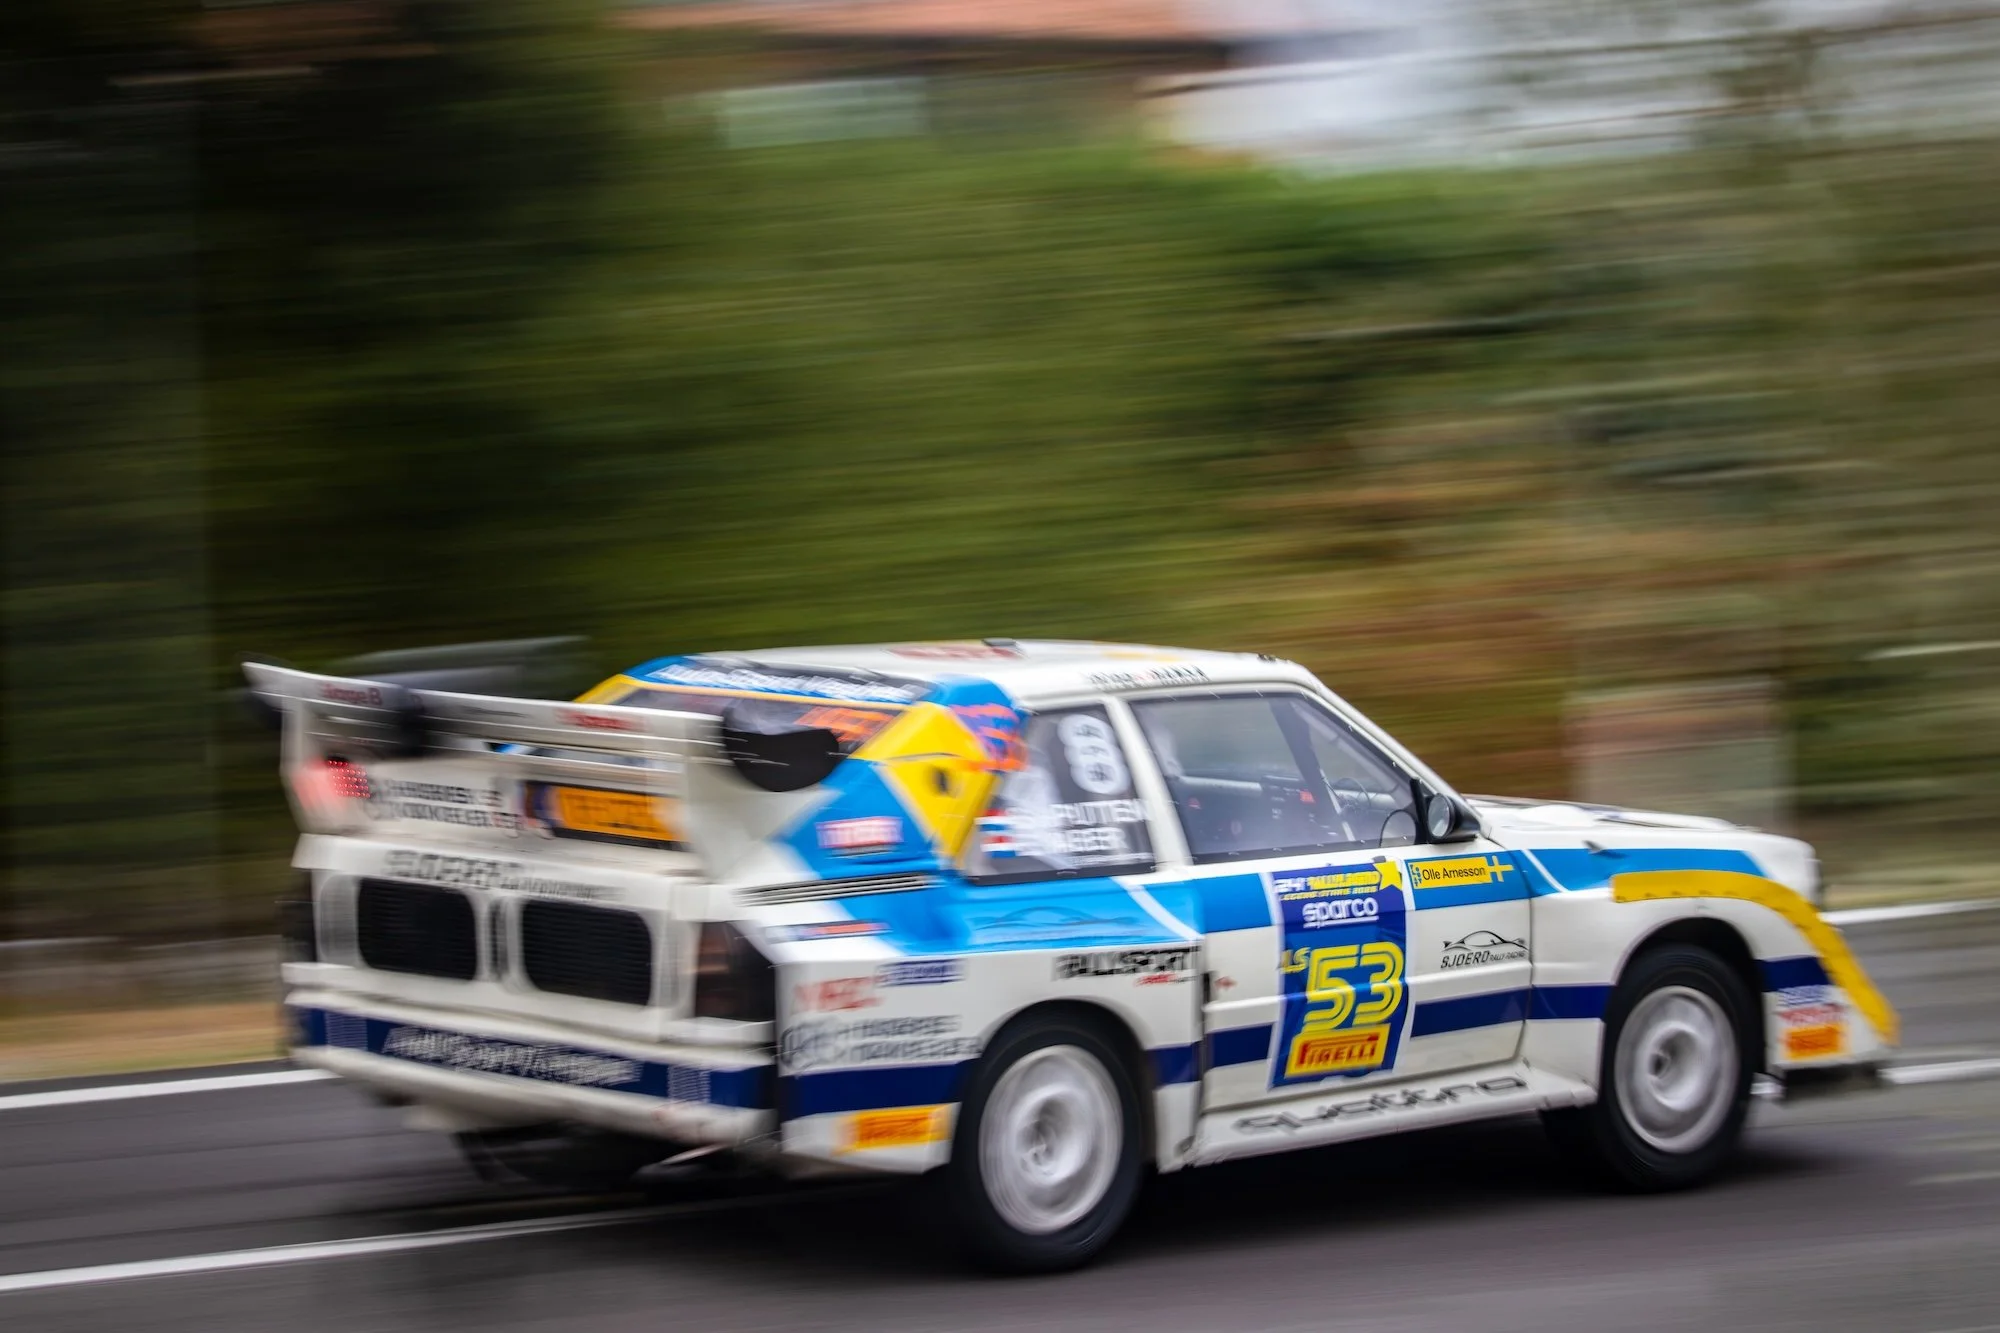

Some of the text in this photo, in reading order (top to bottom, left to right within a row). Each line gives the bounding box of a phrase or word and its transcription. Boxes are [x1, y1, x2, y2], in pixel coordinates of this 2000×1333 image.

[1422, 867, 1486, 881] Olle Arnesson
[1302, 897, 1379, 928] sparco
[1440, 950, 1490, 969] SJOERD
[1303, 942, 1405, 1032] 53
[1296, 1033, 1380, 1068] PIRELLI
